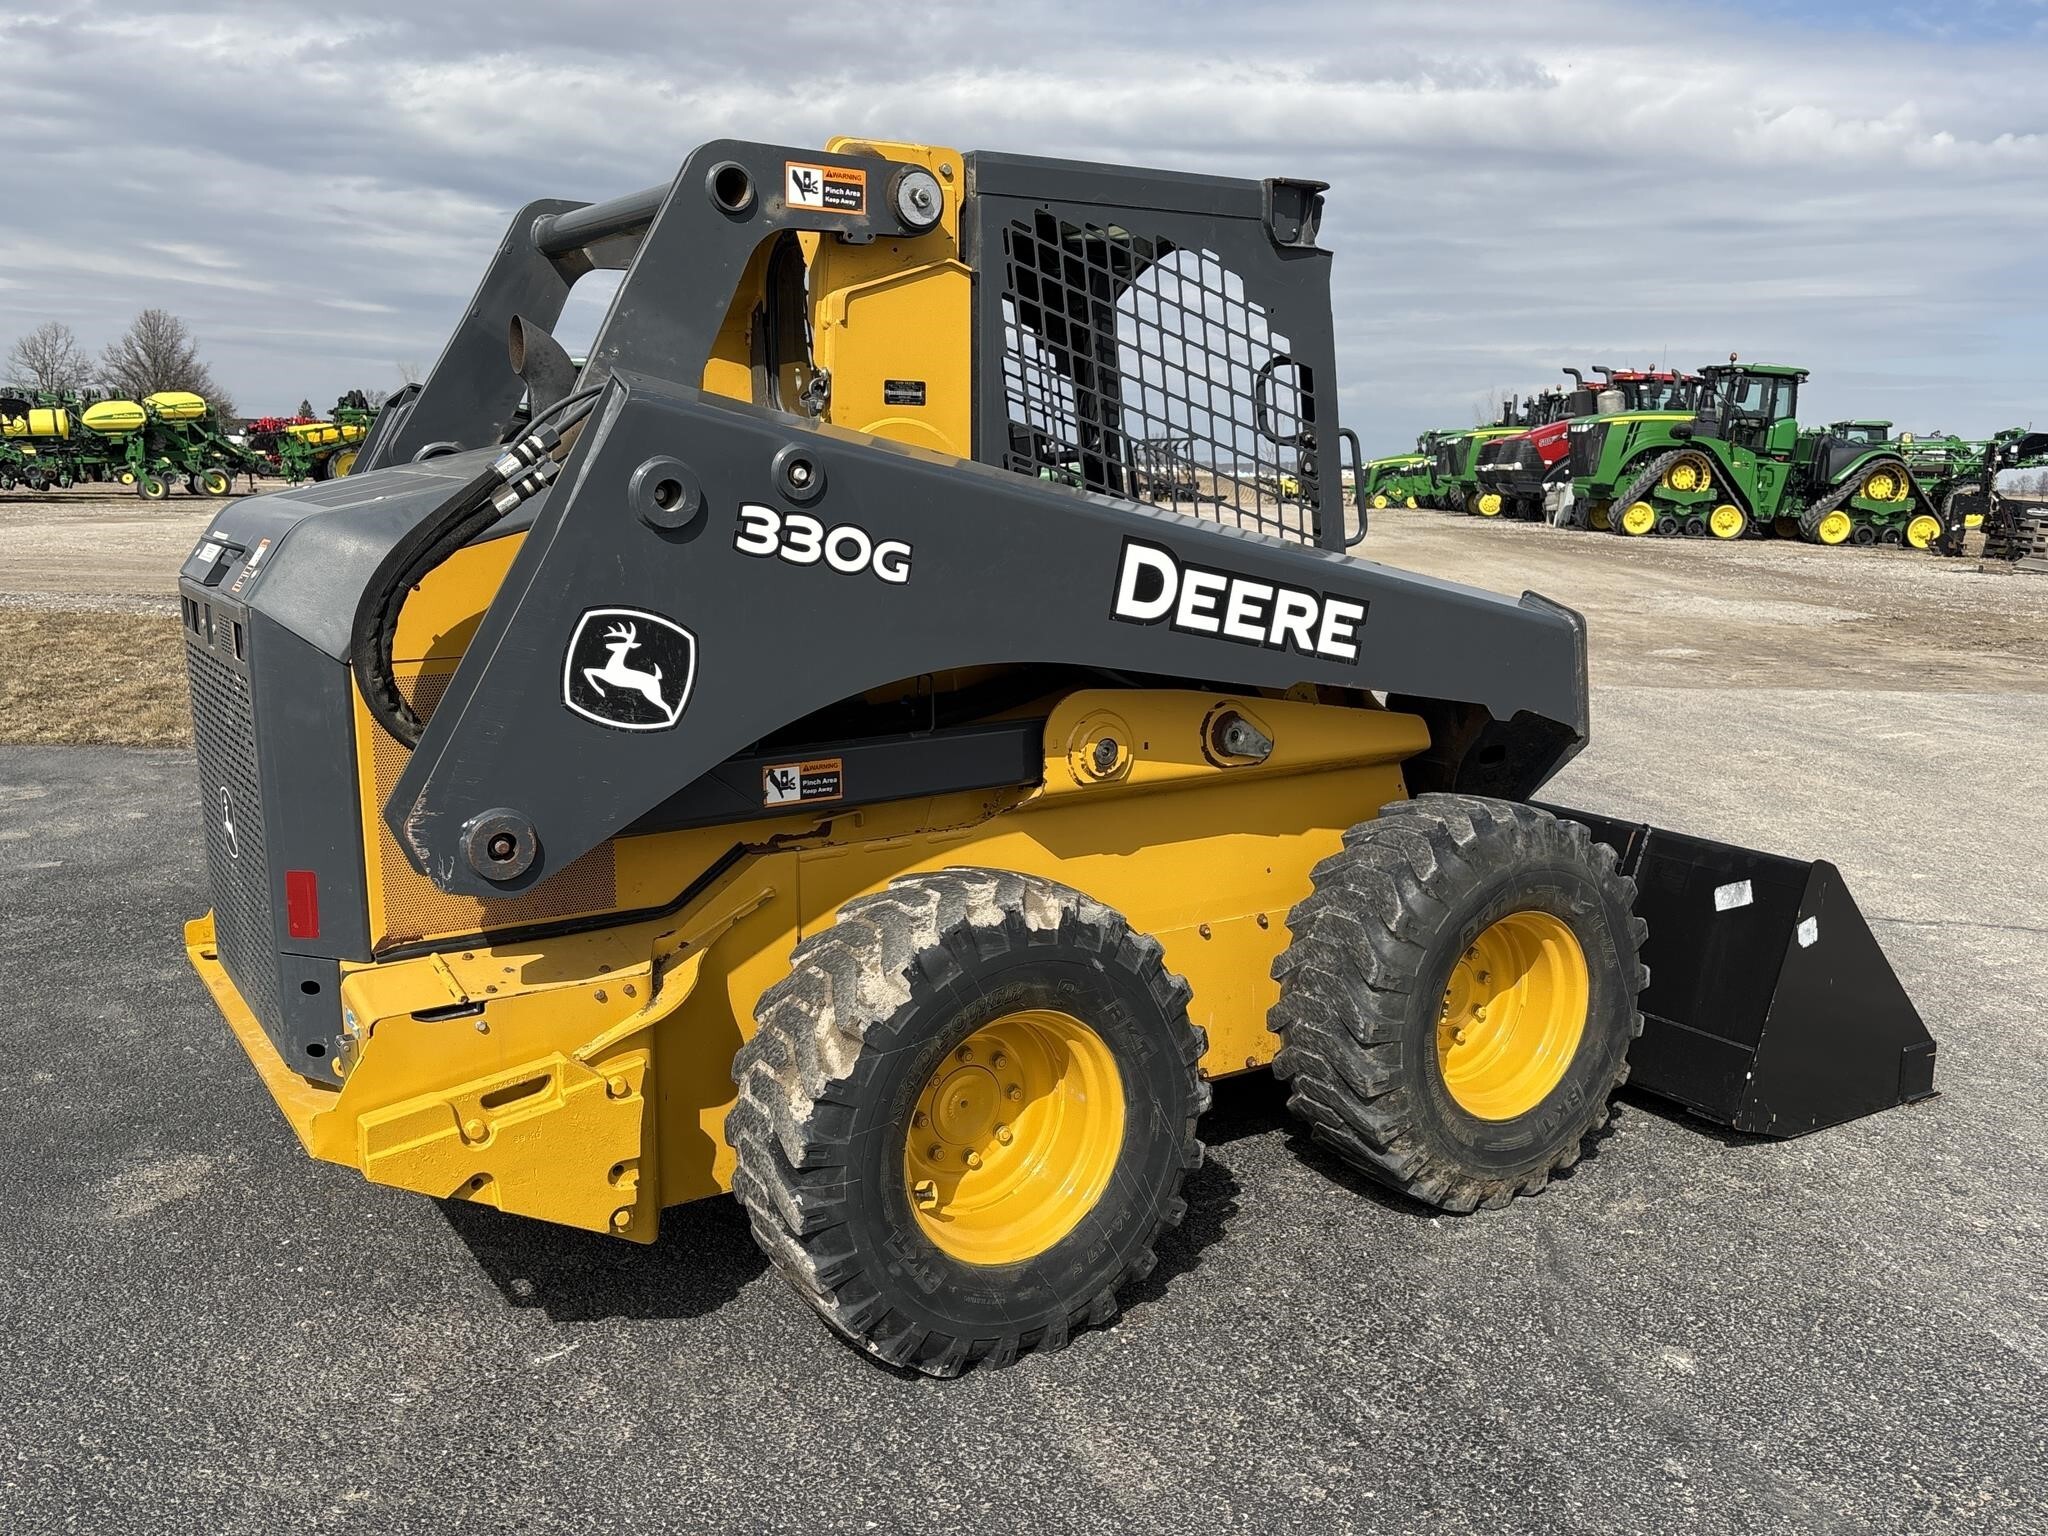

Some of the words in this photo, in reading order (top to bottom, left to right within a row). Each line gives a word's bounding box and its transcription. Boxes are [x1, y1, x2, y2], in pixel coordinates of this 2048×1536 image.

[832, 171, 862, 181] WARNING
[825, 186, 844, 195] Pinch
[845, 188, 861, 197] Area
[825, 195, 840, 204] Keep
[840, 197, 857, 206] Away
[735, 504, 912, 583] 330G
[1113, 541, 1366, 661] DEERE
[809, 762, 839, 771] WARNING
[802, 778, 821, 787] Pinch
[822, 776, 838, 785] Area
[802, 787, 818, 795] Keep
[818, 786, 833, 794] Away
[1540, 1082, 1586, 1140] BKT
[883, 1226, 948, 1294] BKT
